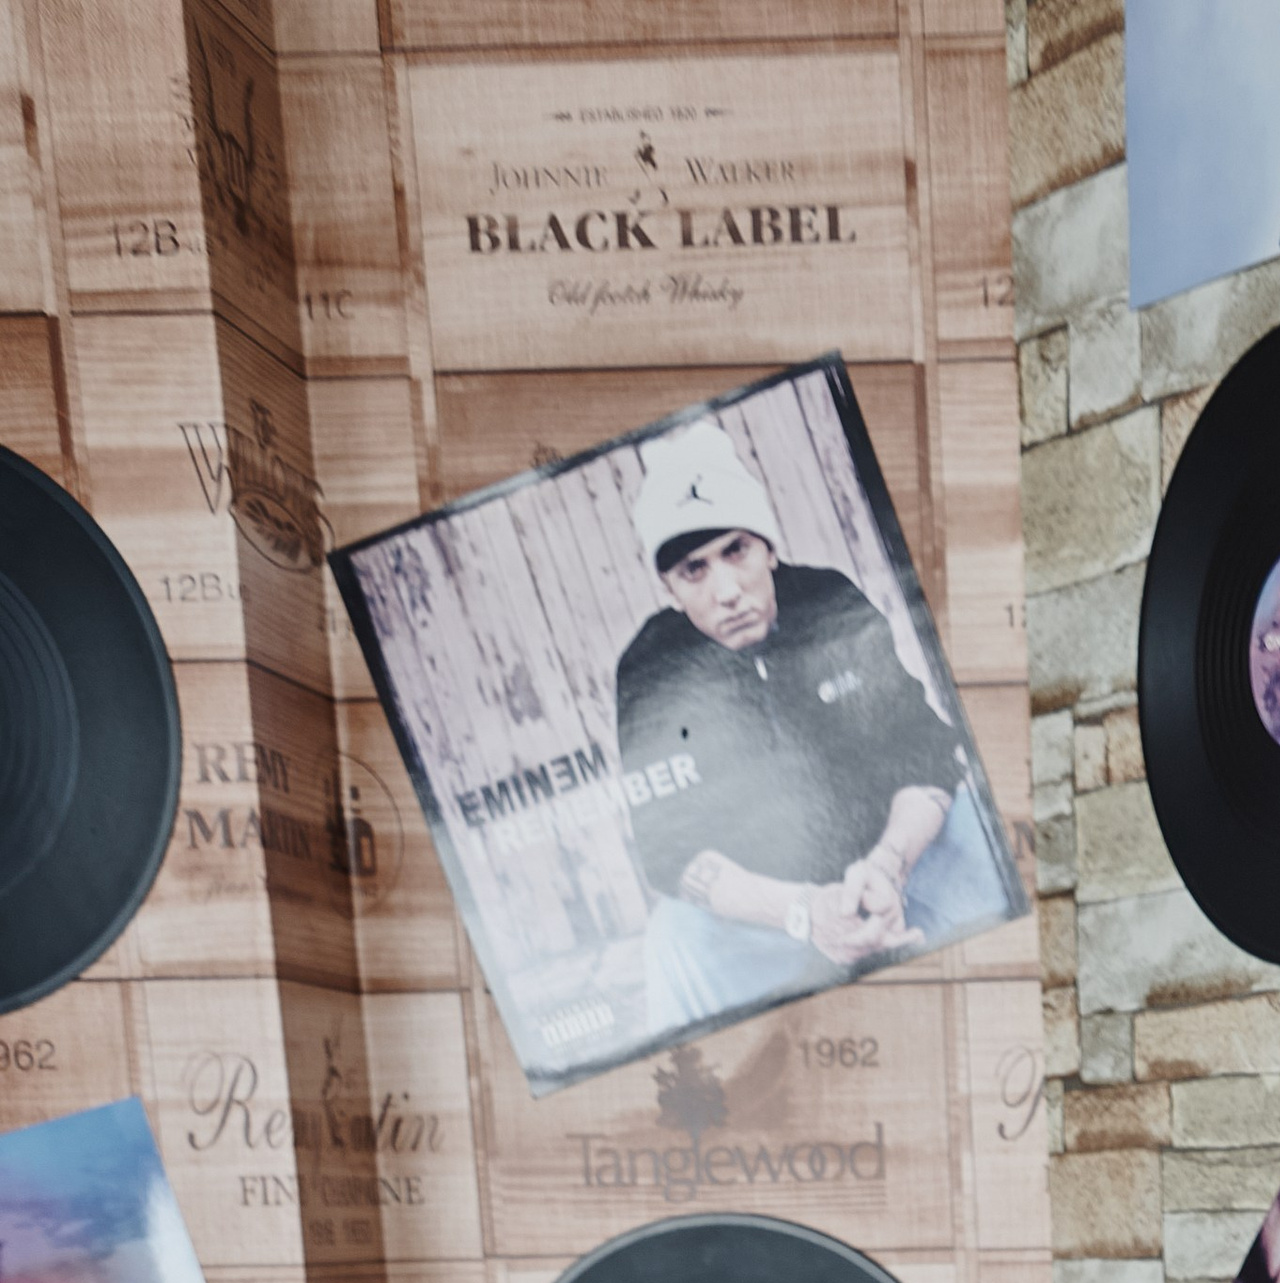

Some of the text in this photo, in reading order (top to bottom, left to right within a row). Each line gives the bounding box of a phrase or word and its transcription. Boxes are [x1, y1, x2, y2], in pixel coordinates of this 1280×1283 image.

[464, 204, 858, 254] BLACK LABEL
[800, 1036, 881, 1070] 1962
[565, 1120, 888, 1202] Tanglewood
